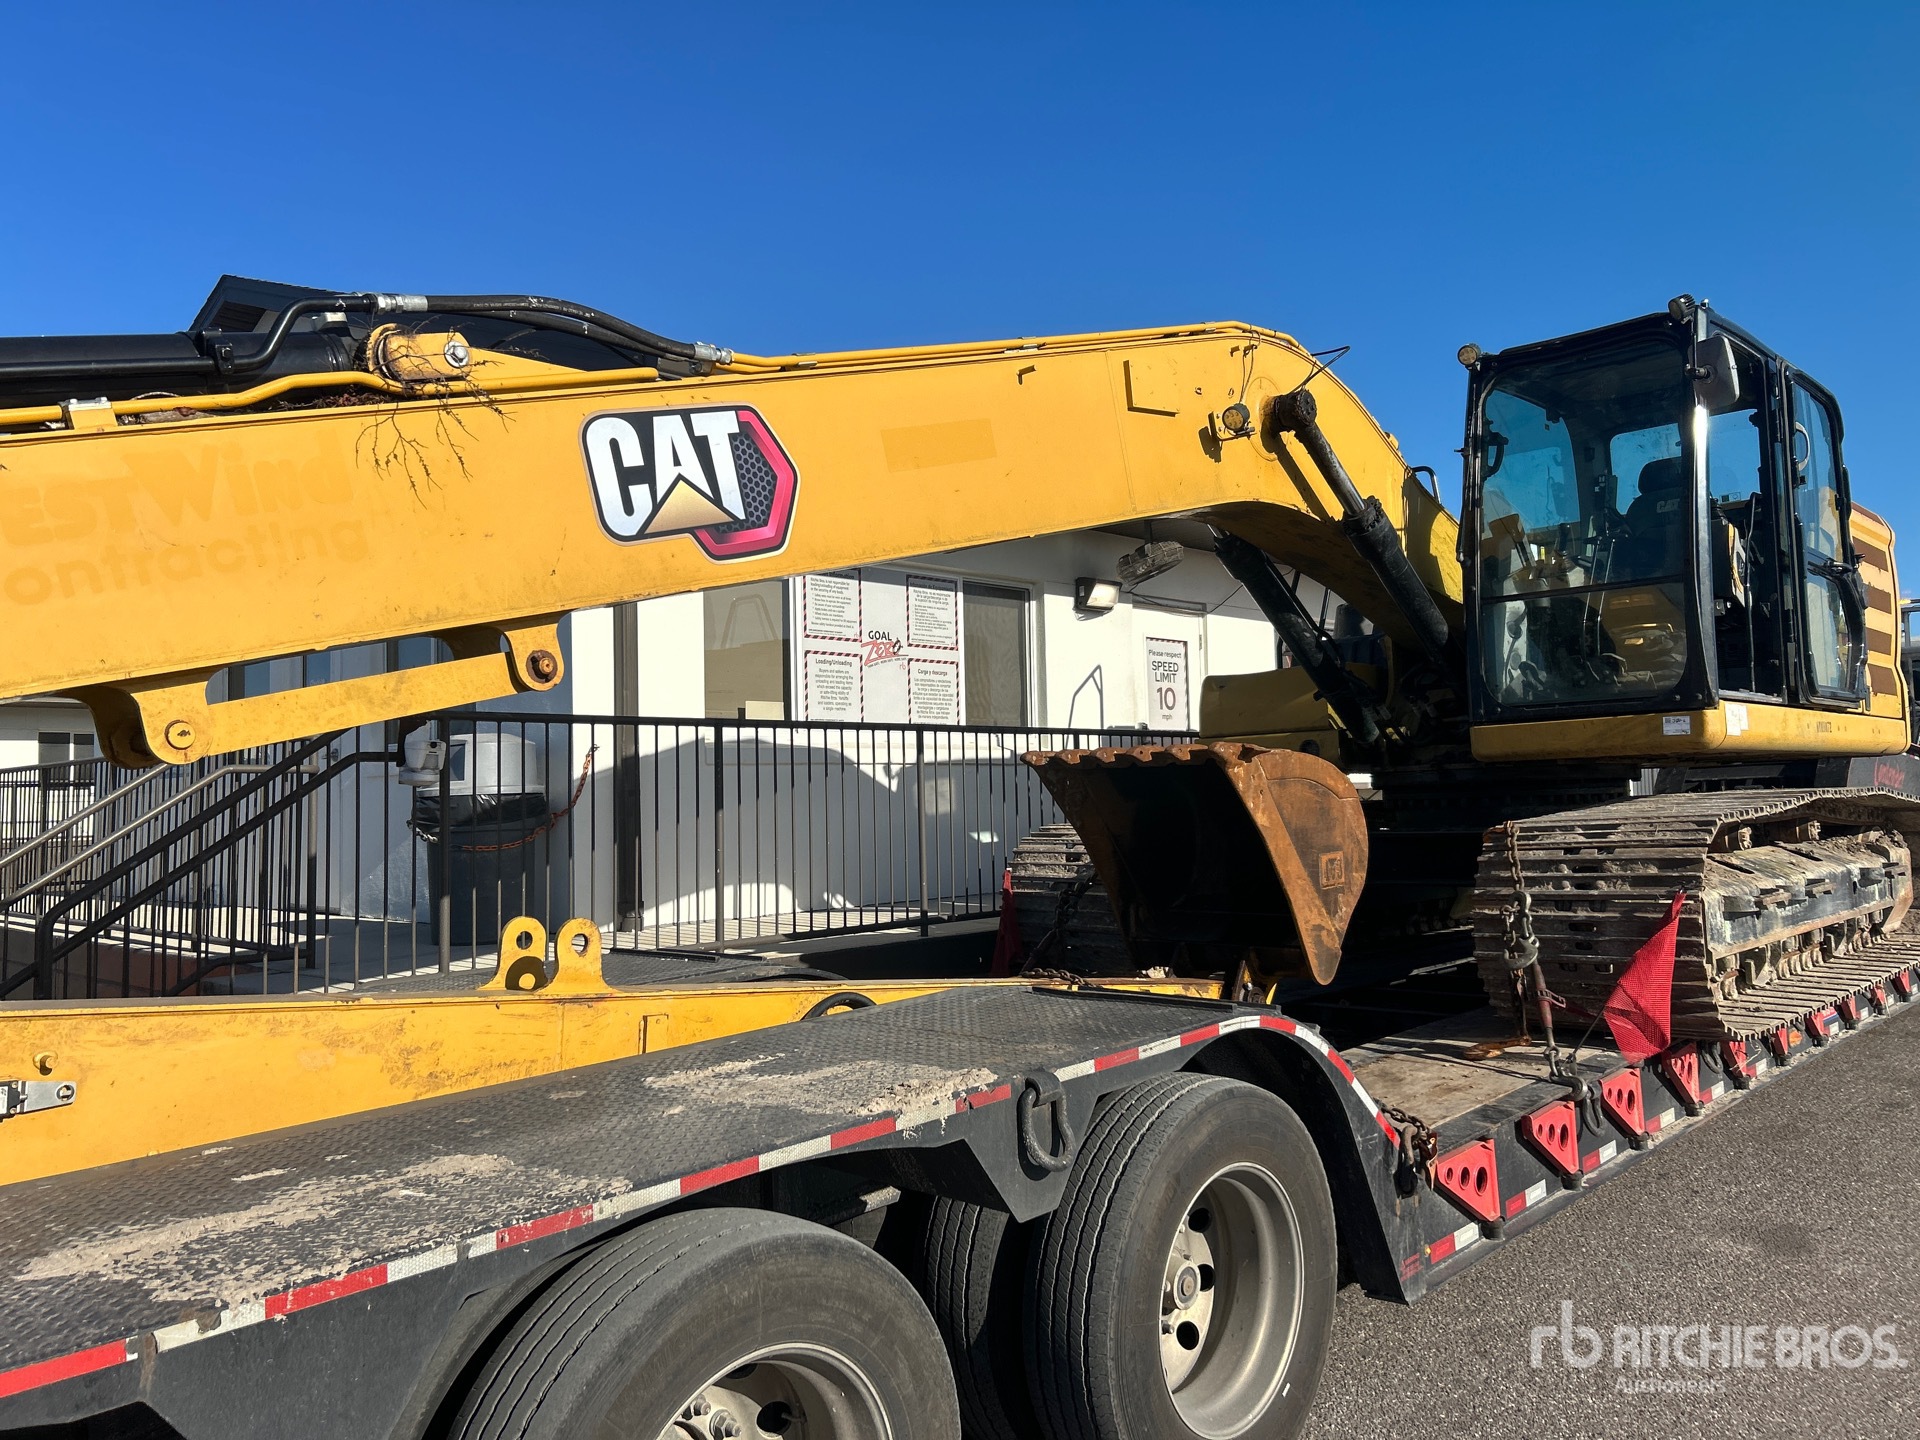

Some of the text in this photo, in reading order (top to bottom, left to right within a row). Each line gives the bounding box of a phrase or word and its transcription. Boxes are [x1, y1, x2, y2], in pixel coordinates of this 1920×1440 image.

[586, 410, 746, 536] CAT
[868, 630, 893, 641] GOAL
[861, 637, 903, 666] ZERO
[1148, 649, 1182, 659] Please respect
[816, 658, 852, 667] Loading/Unloading
[1151, 660, 1179, 672] SPEED
[1154, 672, 1177, 683] LIMIT
[1156, 686, 1176, 711] 10
